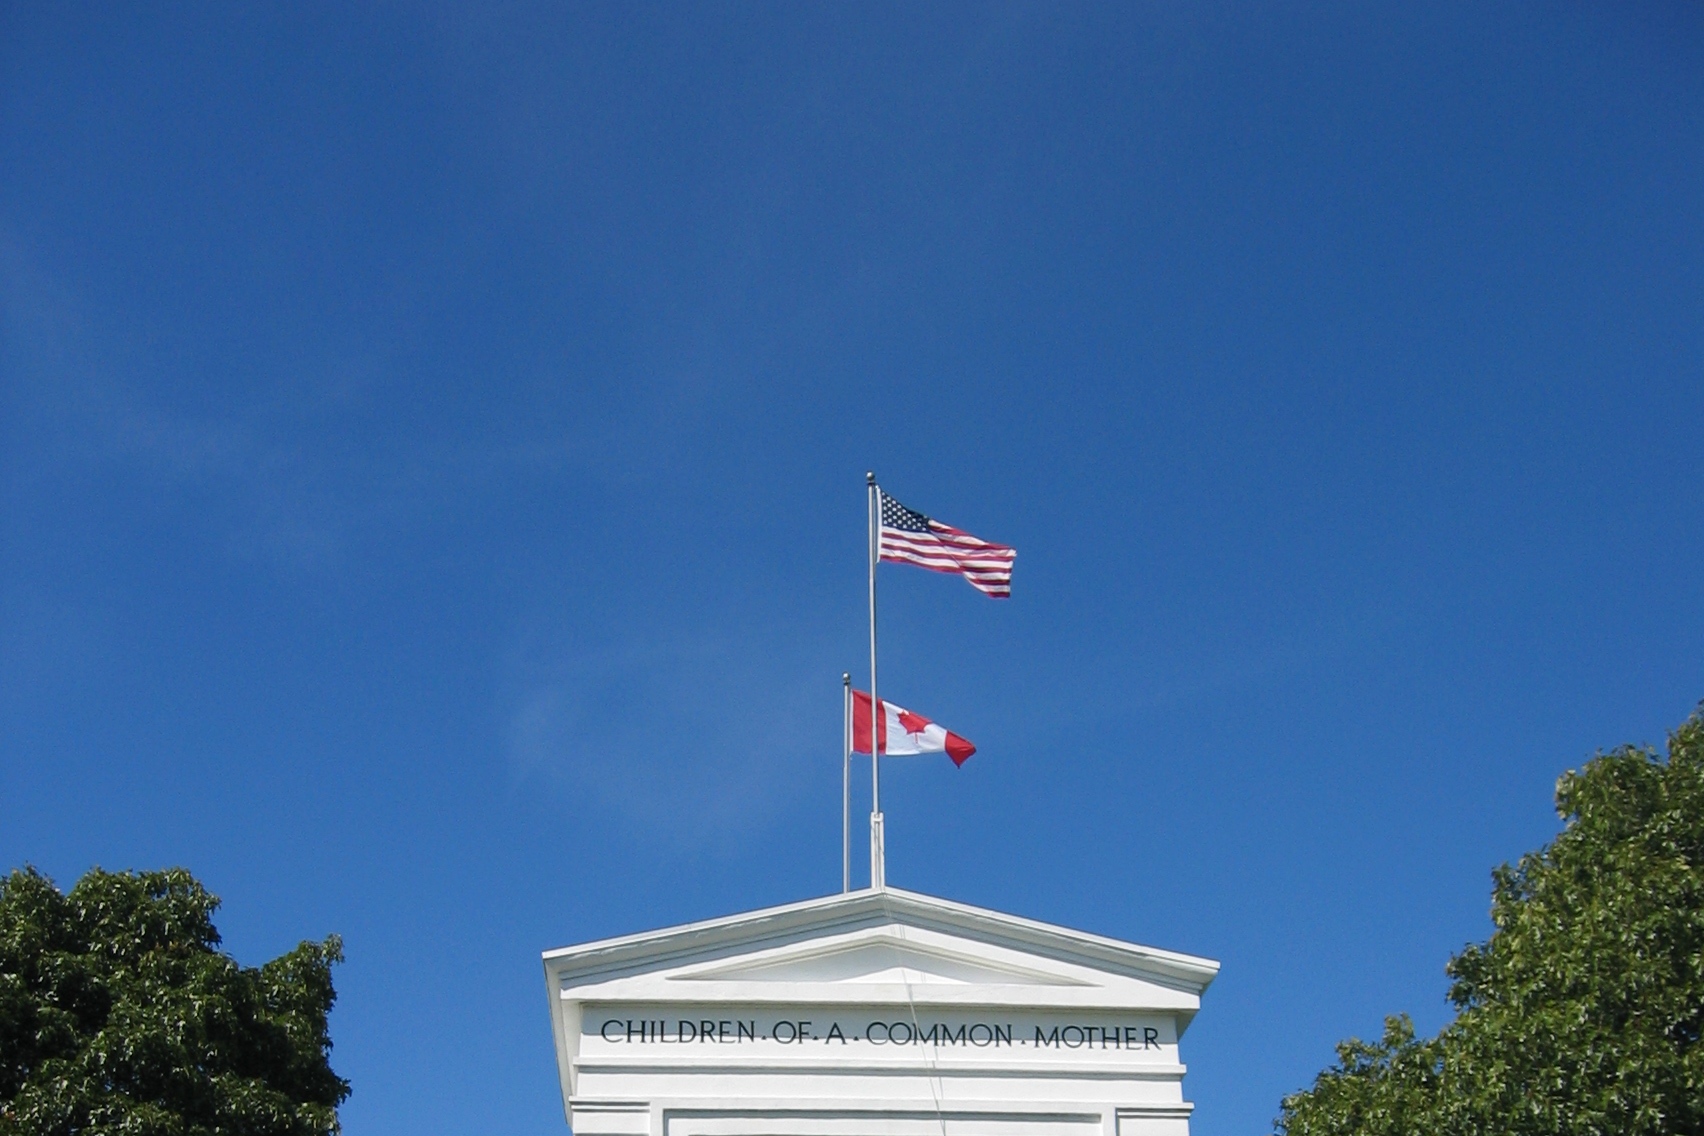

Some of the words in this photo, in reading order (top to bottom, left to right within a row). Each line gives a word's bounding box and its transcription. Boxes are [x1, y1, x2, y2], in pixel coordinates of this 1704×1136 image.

[601, 1019, 755, 1043] CHILDREN
[772, 1020, 812, 1045] OF
[825, 1022, 847, 1045] A
[866, 1021, 1012, 1046] COMMON
[1034, 1025, 1162, 1051] MOTHER
